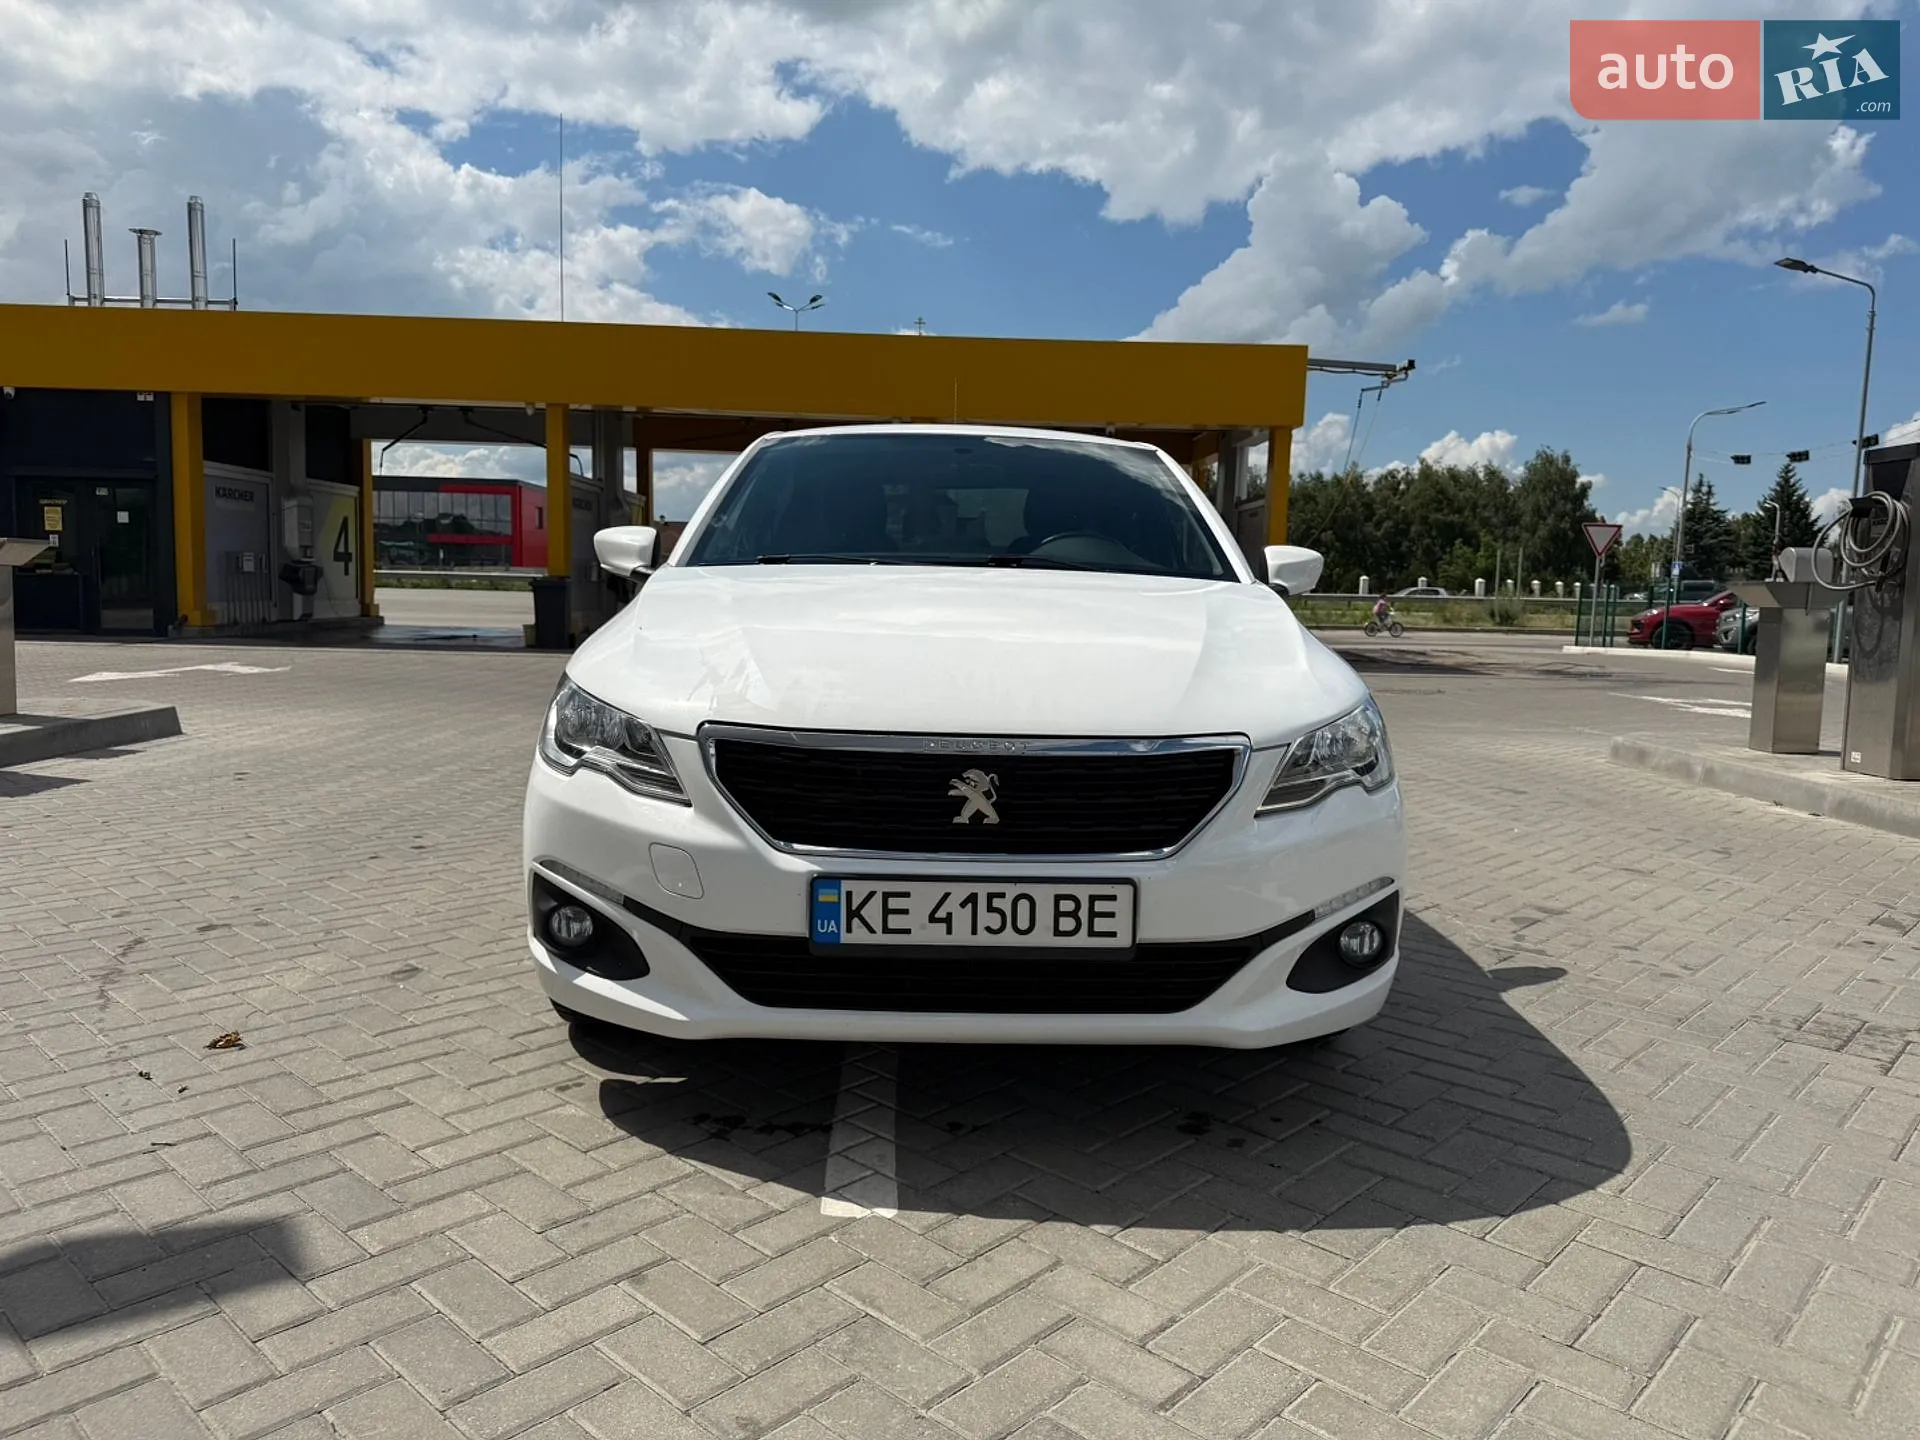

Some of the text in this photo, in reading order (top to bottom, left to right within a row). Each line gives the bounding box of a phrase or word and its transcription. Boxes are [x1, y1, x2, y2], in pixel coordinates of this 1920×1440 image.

[333, 515, 353, 577] 4
[816, 919, 838, 934] UA
[845, 890, 1118, 938] KE 4150 BE
